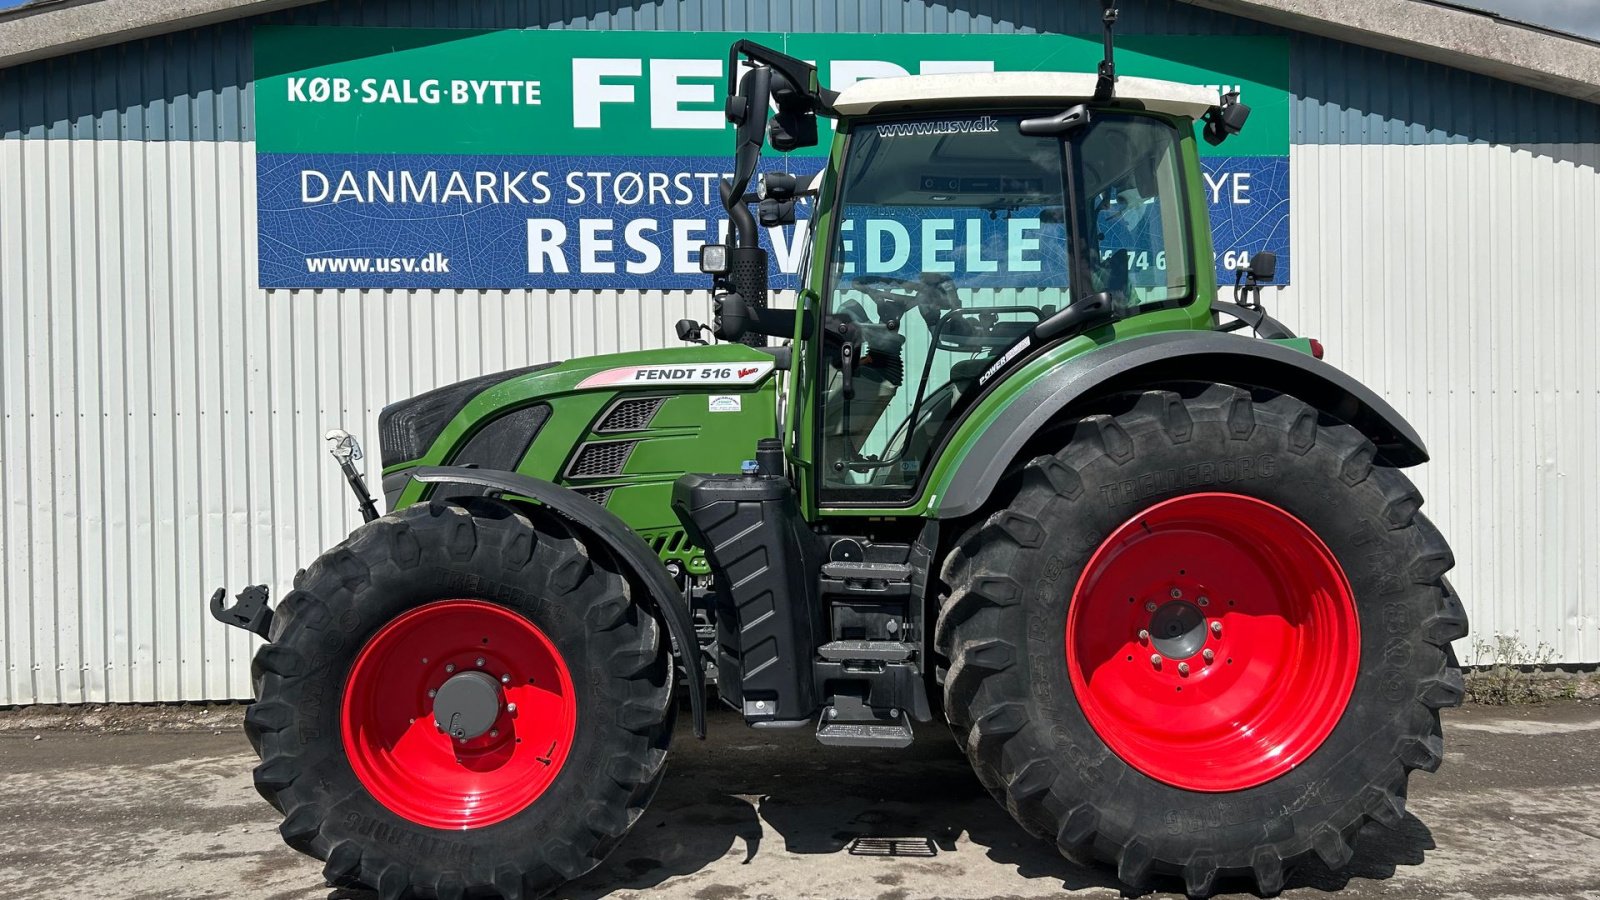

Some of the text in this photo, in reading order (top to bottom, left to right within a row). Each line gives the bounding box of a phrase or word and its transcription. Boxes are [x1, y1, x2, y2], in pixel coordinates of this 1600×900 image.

[877, 116, 999, 137] www.usv.dk
[301, 170, 551, 203] DANMARKS
[568, 171, 737, 205] STØRST
[306, 253, 450, 273] www.usv.dk
[1224, 251, 1250, 270] 64
[635, 369, 697, 380] FENDT
[701, 368, 731, 379] 516
[1100, 454, 1277, 508] TRELLEBORG
